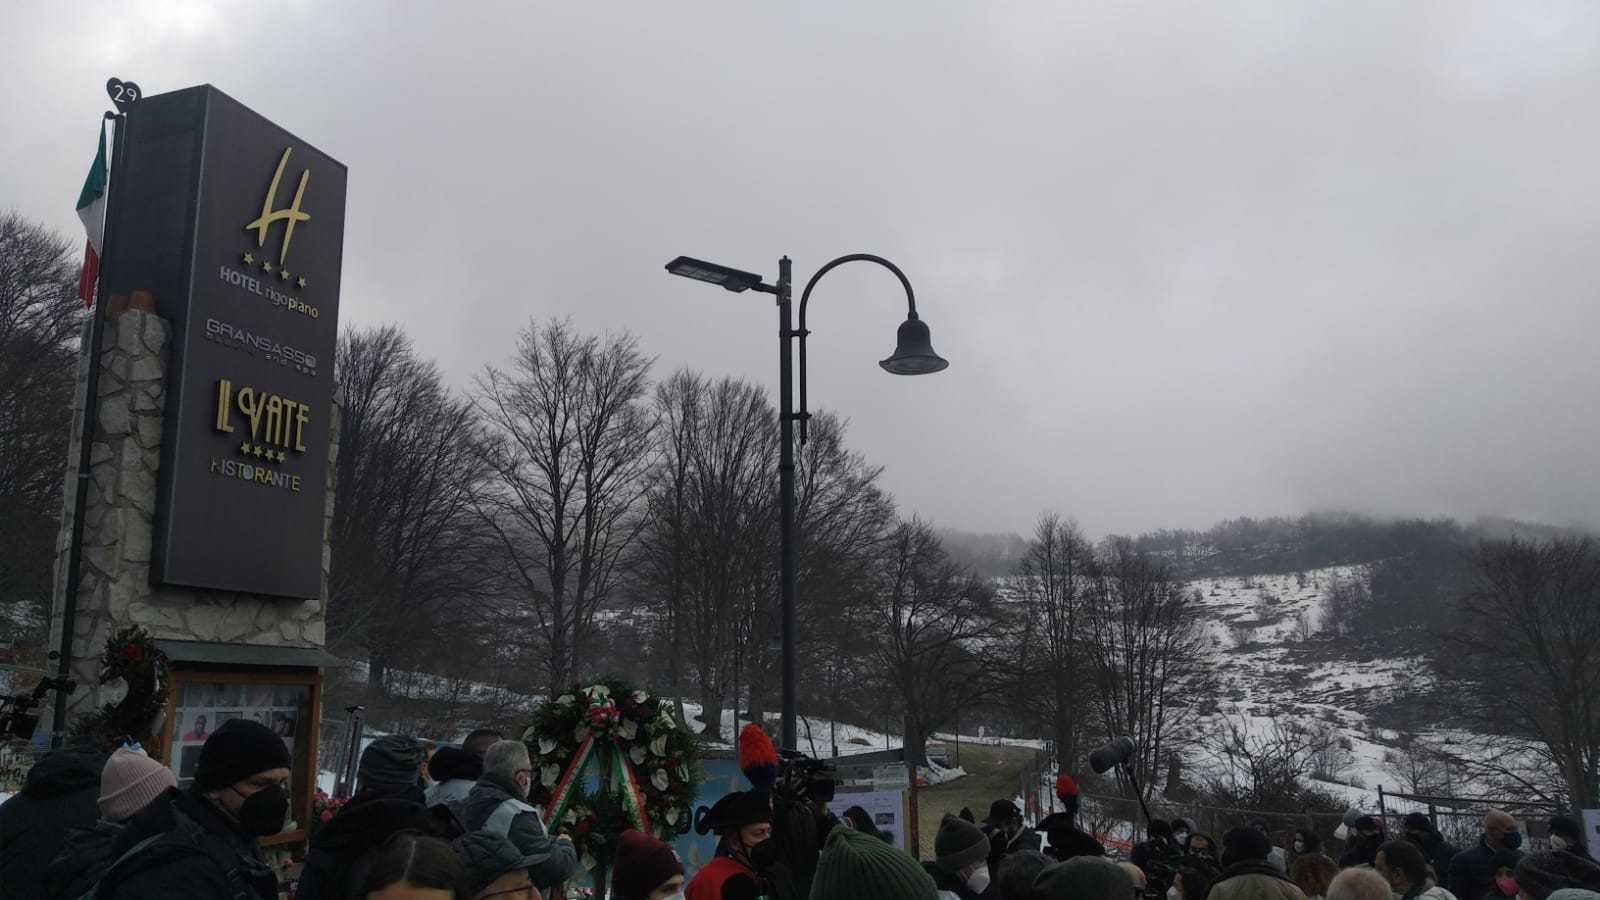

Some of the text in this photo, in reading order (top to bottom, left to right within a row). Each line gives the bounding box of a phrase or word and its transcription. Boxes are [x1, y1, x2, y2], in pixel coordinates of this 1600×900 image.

[114, 84, 137, 102] 29
[246, 147, 311, 265] H
[219, 265, 319, 319] HOTEL rigopiano
[206, 318, 317, 369] GRANSASSO
[216, 378, 310, 452] IL VATE
